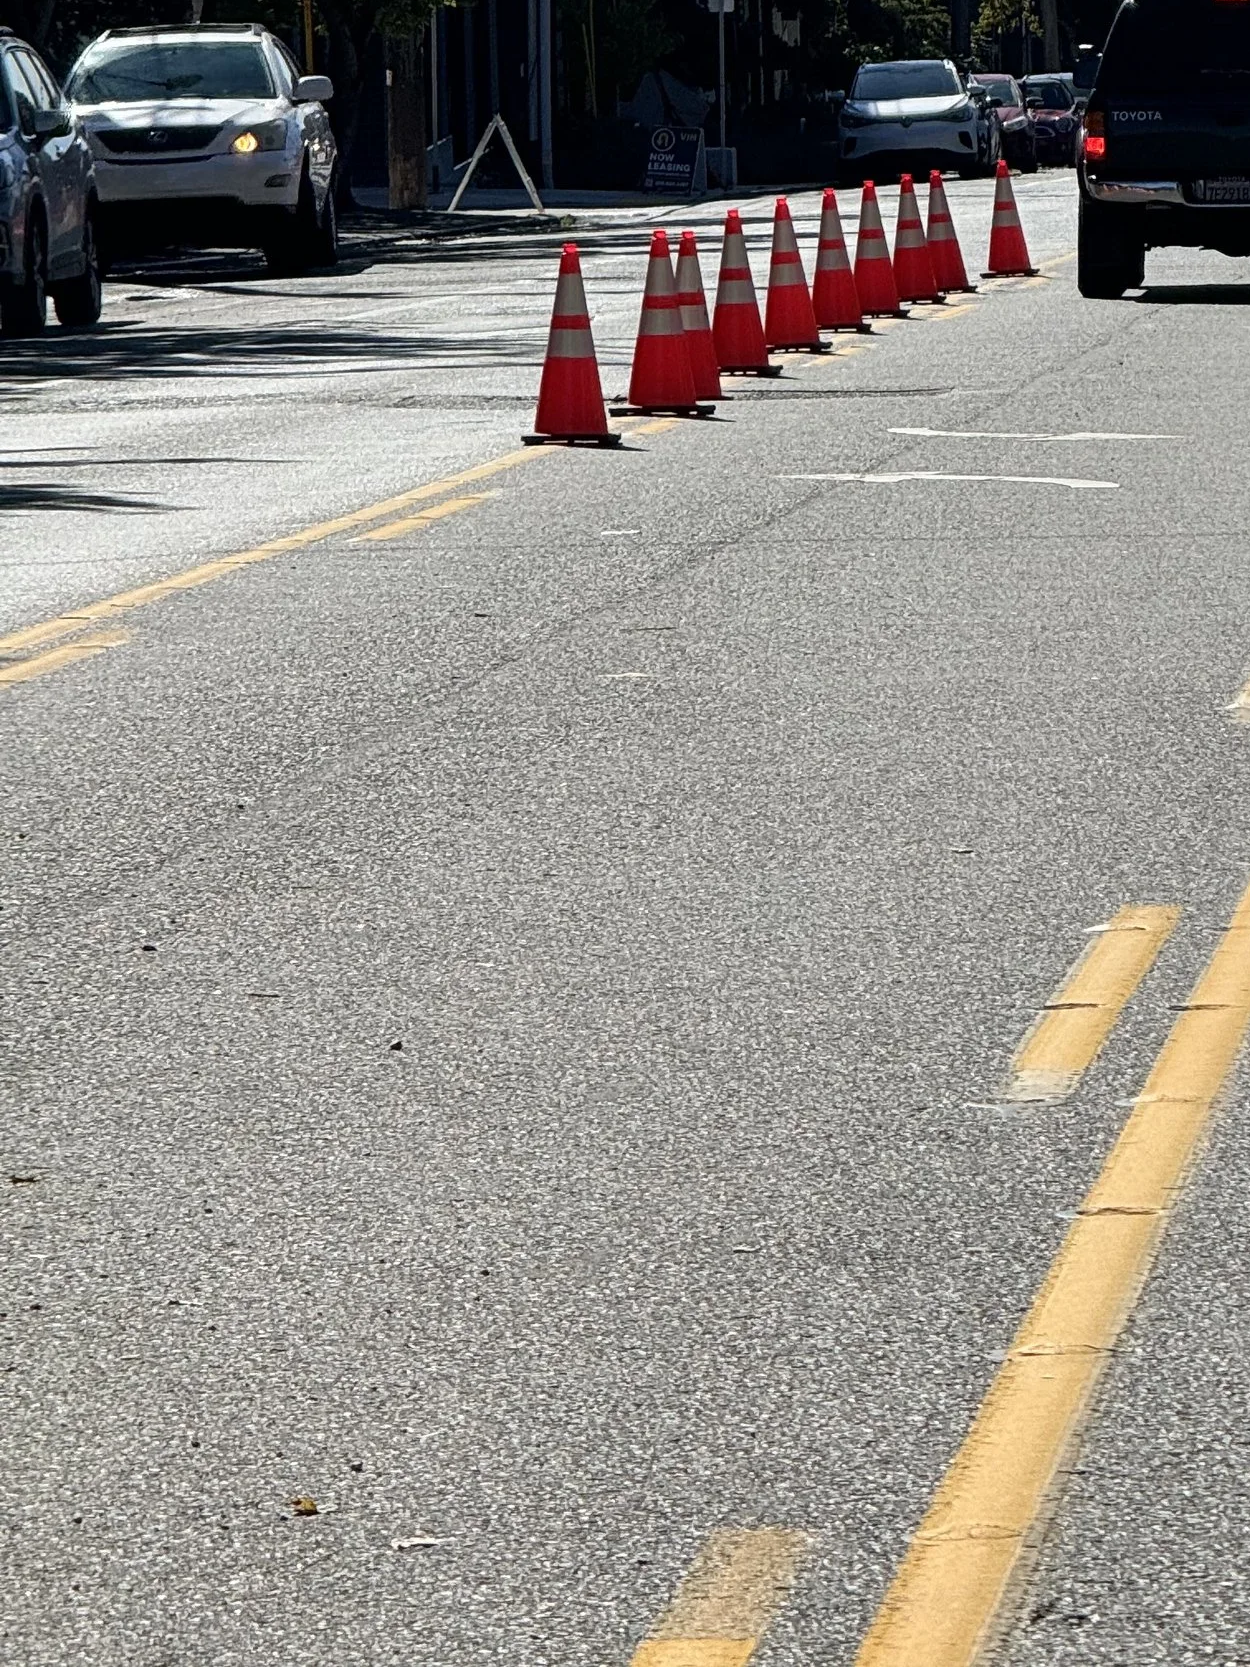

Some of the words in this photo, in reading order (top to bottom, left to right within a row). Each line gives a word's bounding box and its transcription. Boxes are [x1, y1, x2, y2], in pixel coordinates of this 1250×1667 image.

[1111, 110, 1163, 122] TOYOTA
[649, 152, 675, 162] NOW
[647, 162, 691, 172] LEASING
